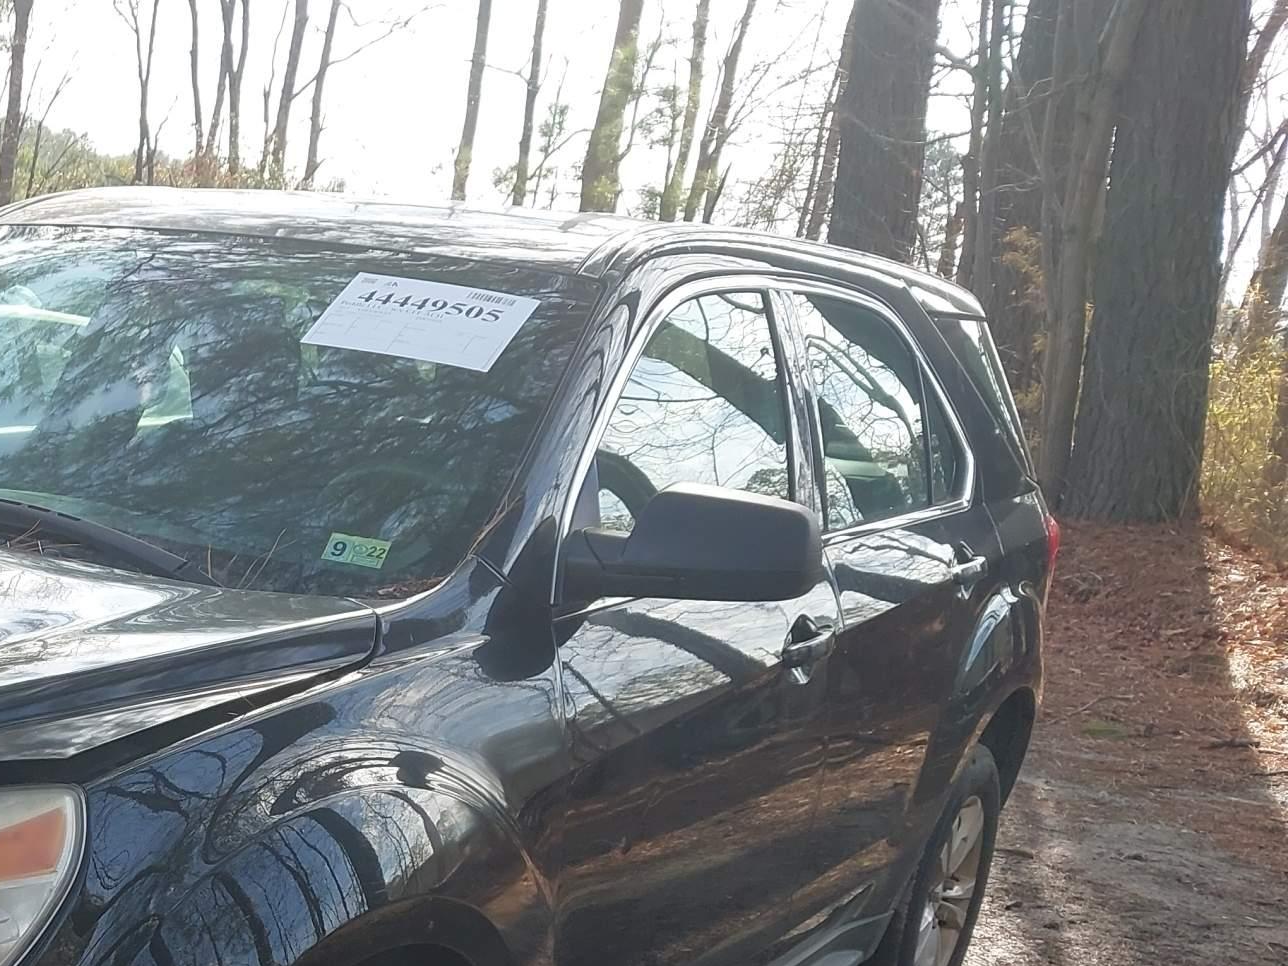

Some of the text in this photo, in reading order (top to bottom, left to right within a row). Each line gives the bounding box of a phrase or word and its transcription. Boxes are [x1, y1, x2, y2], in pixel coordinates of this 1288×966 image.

[358, 290, 504, 323] 44449505
[330, 541, 386, 560] 9 22
